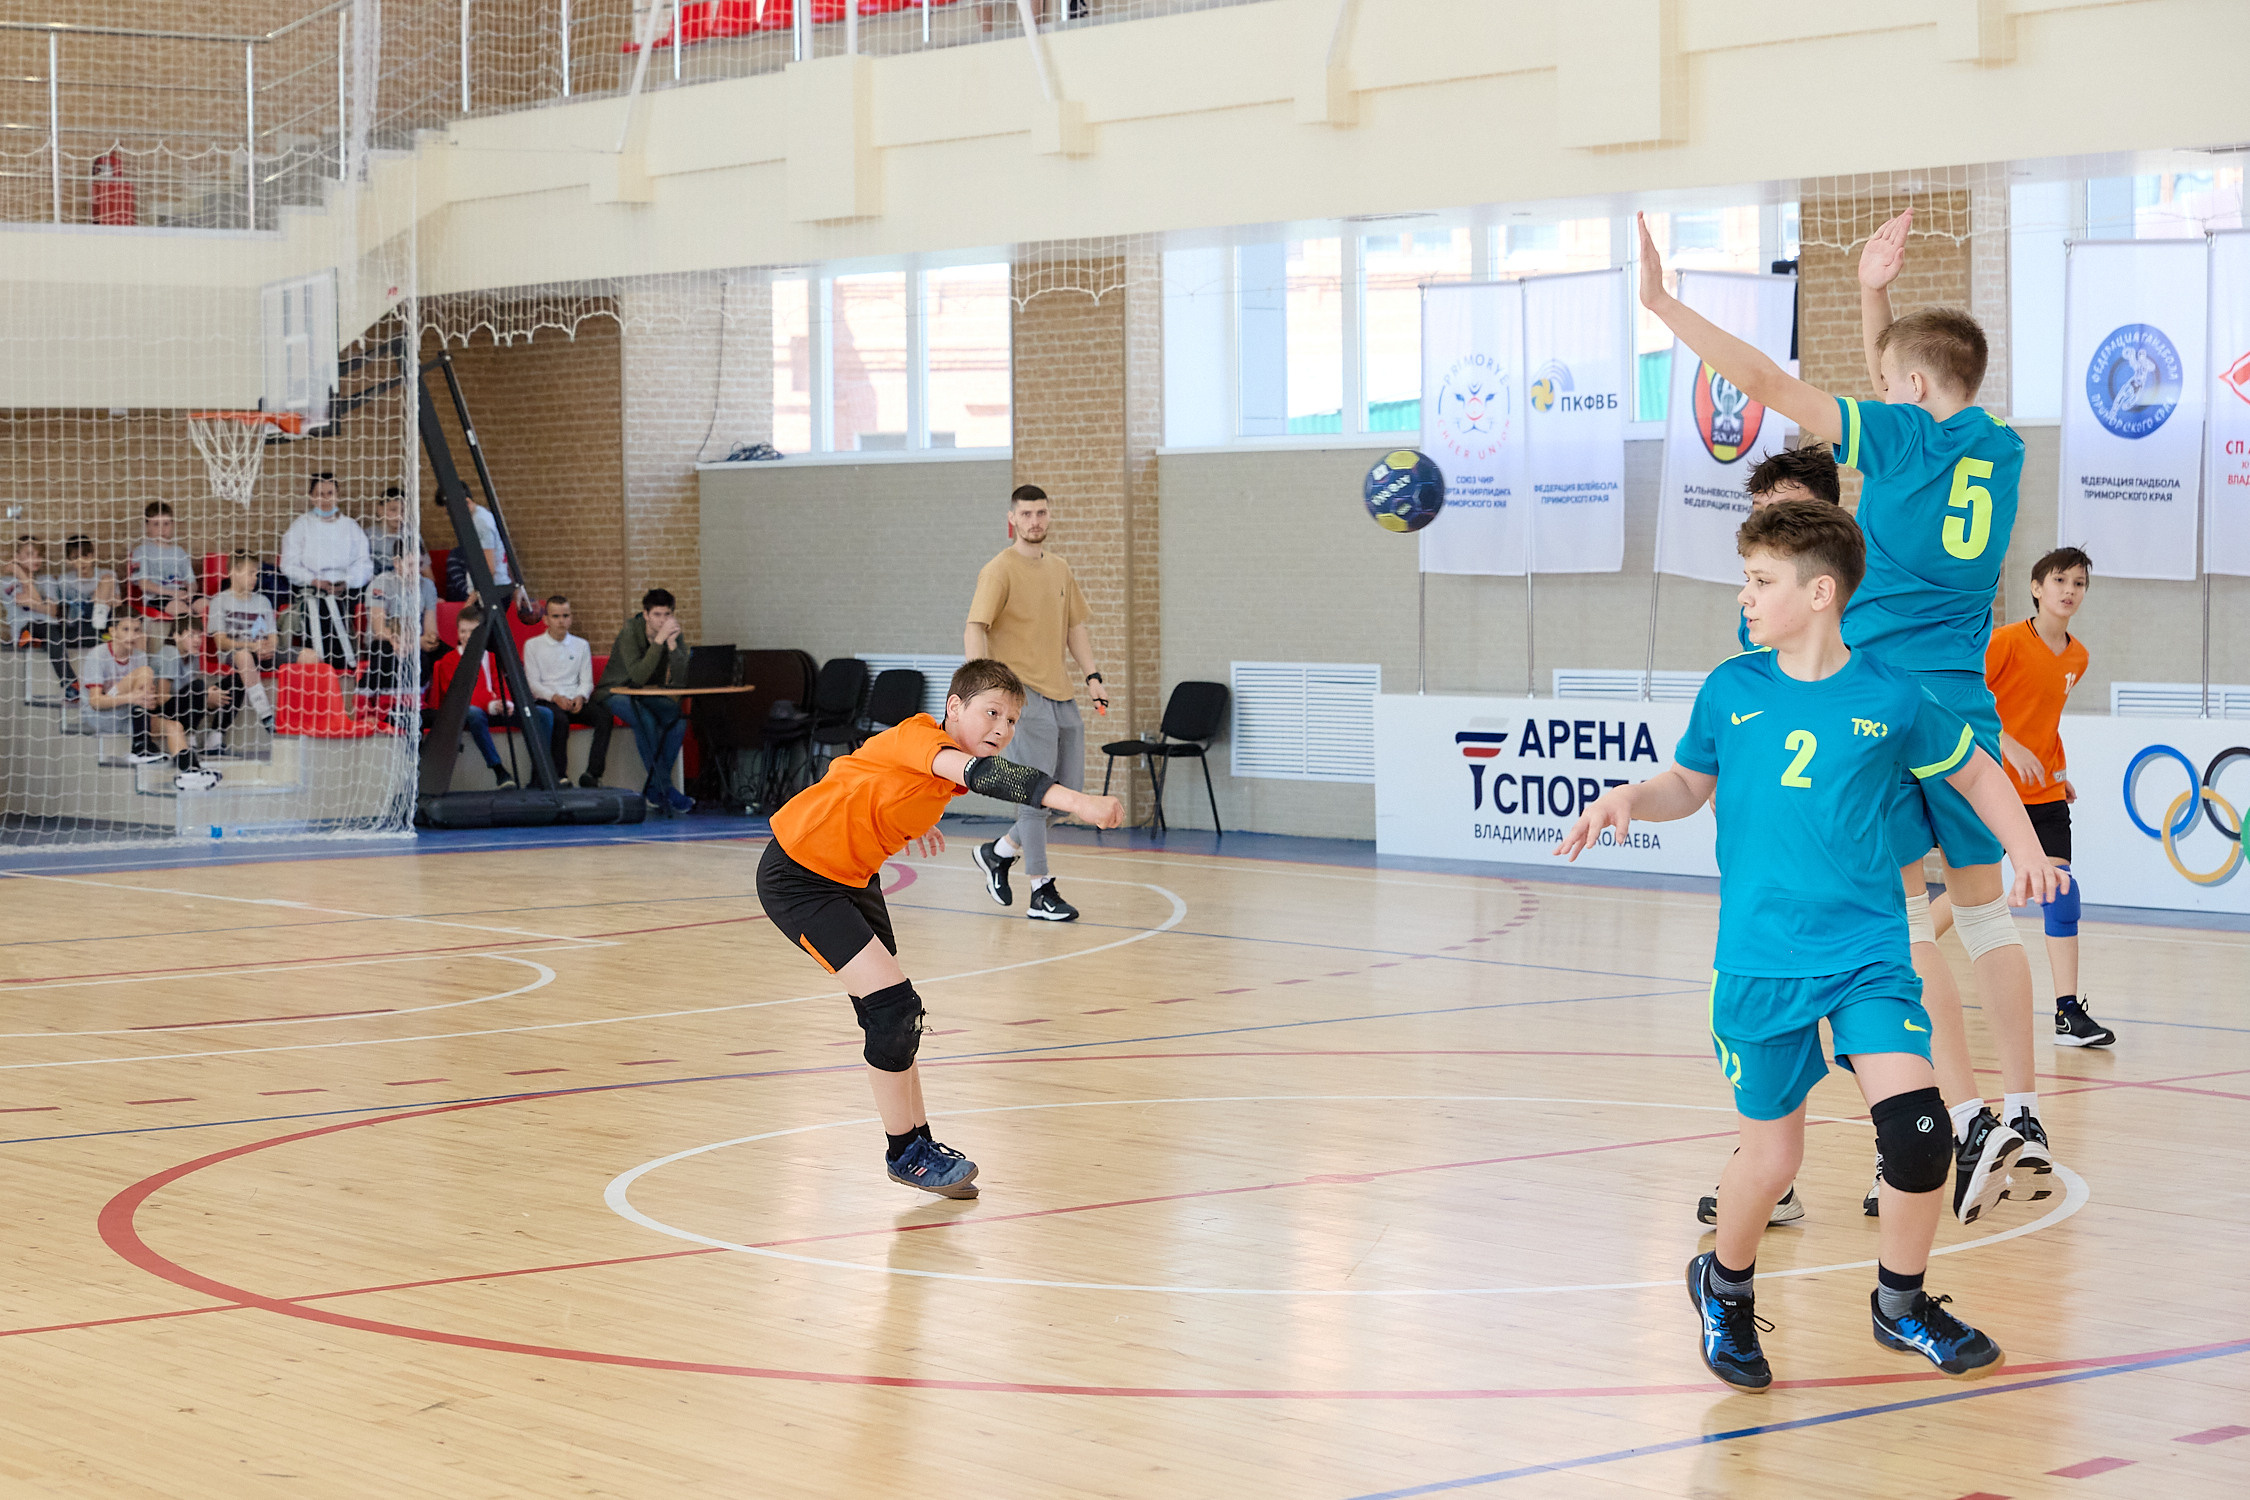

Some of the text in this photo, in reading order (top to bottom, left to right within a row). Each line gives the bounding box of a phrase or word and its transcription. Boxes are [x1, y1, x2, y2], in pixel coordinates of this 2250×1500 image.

[1443, 353, 1509, 386] PRIMORYE
[1561, 393, 1618, 411] ПКФВБ
[1942, 456, 1994, 560] 5
[2149, 493, 2173, 501] КРАЯ
[1518, 719, 1659, 763] АРЕНА
[1780, 730, 1818, 788] 2
[1474, 823, 1564, 844] ВЛАДИМИРА
